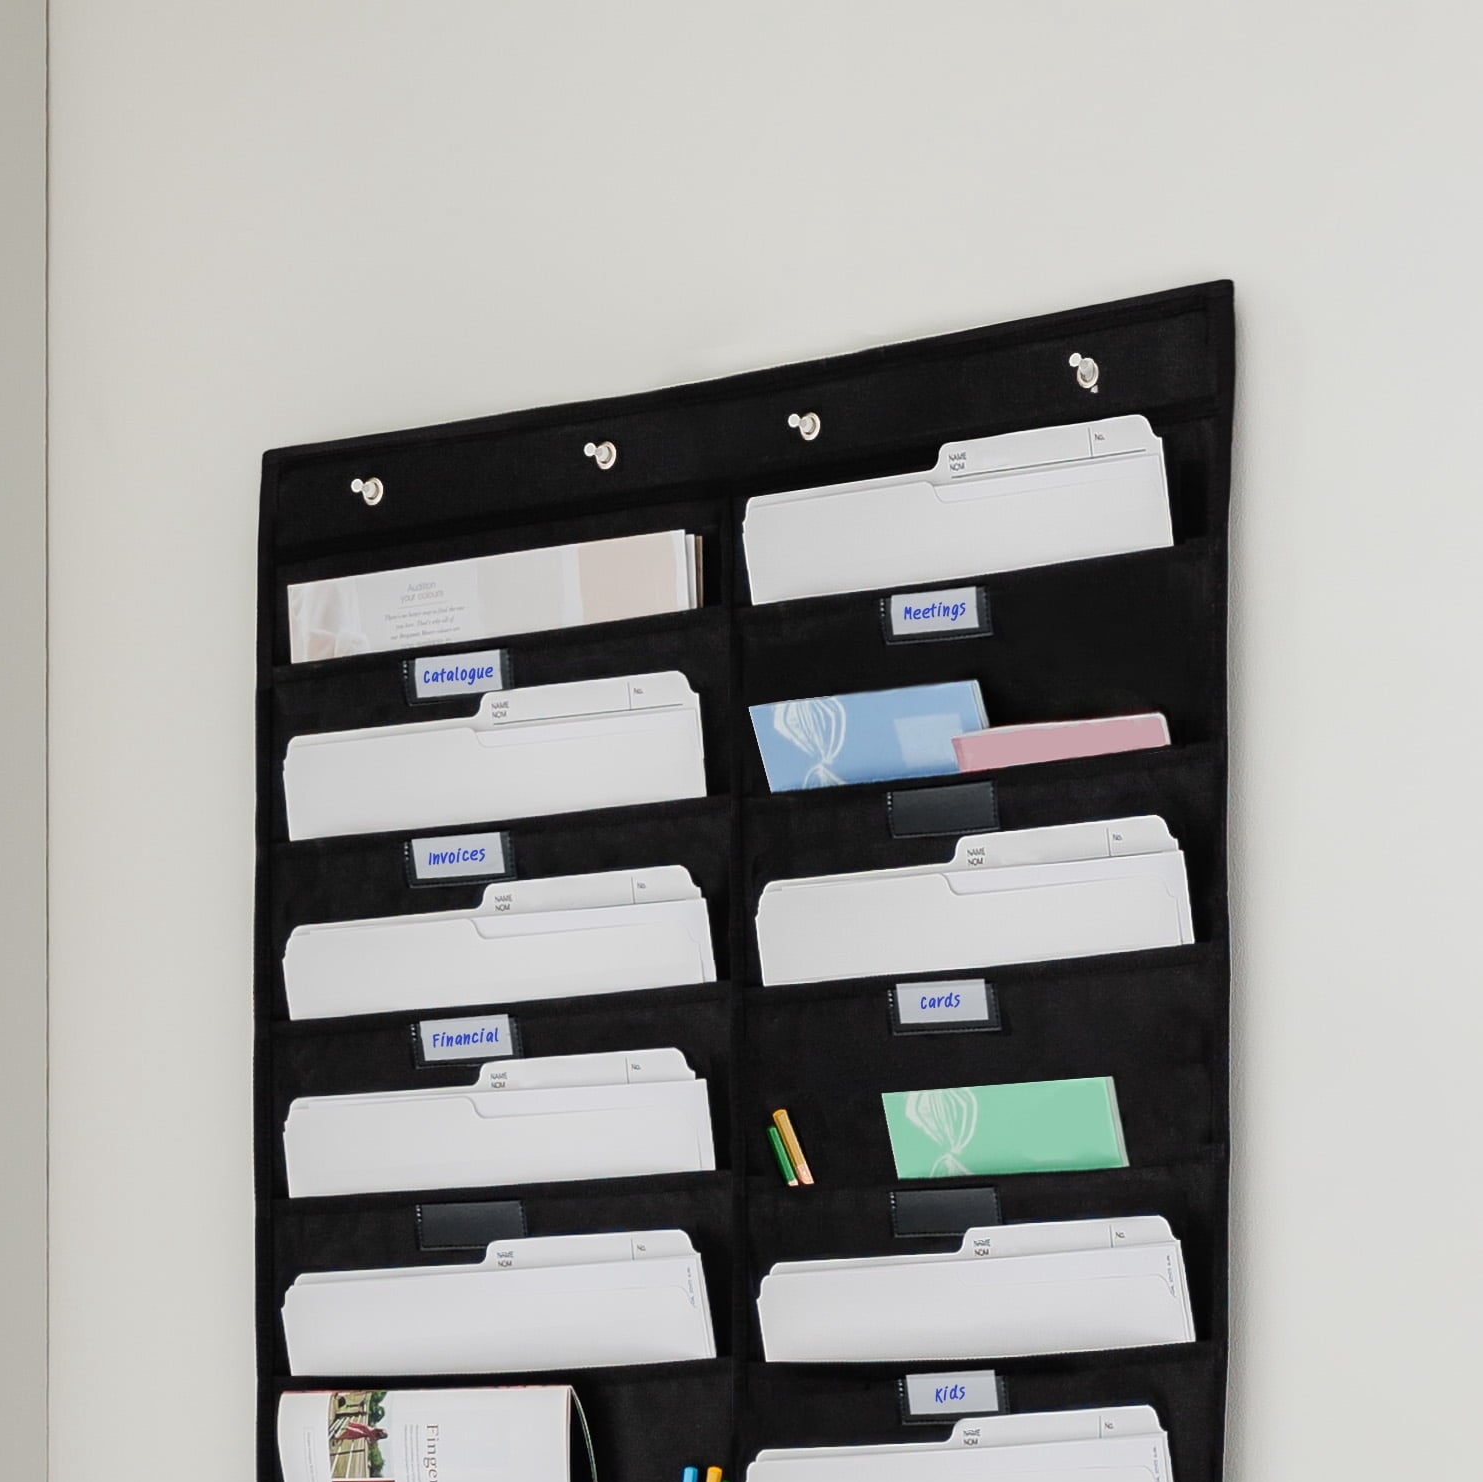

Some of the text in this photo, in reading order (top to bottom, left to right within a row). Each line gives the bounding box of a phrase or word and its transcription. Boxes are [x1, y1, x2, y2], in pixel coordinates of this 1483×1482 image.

[903, 602, 966, 621] Meetings
[423, 666, 494, 685] Catalogue
[428, 848, 486, 865] Invoices
[432, 1027, 499, 1047] Financial
[935, 1384, 966, 1403] Kids
